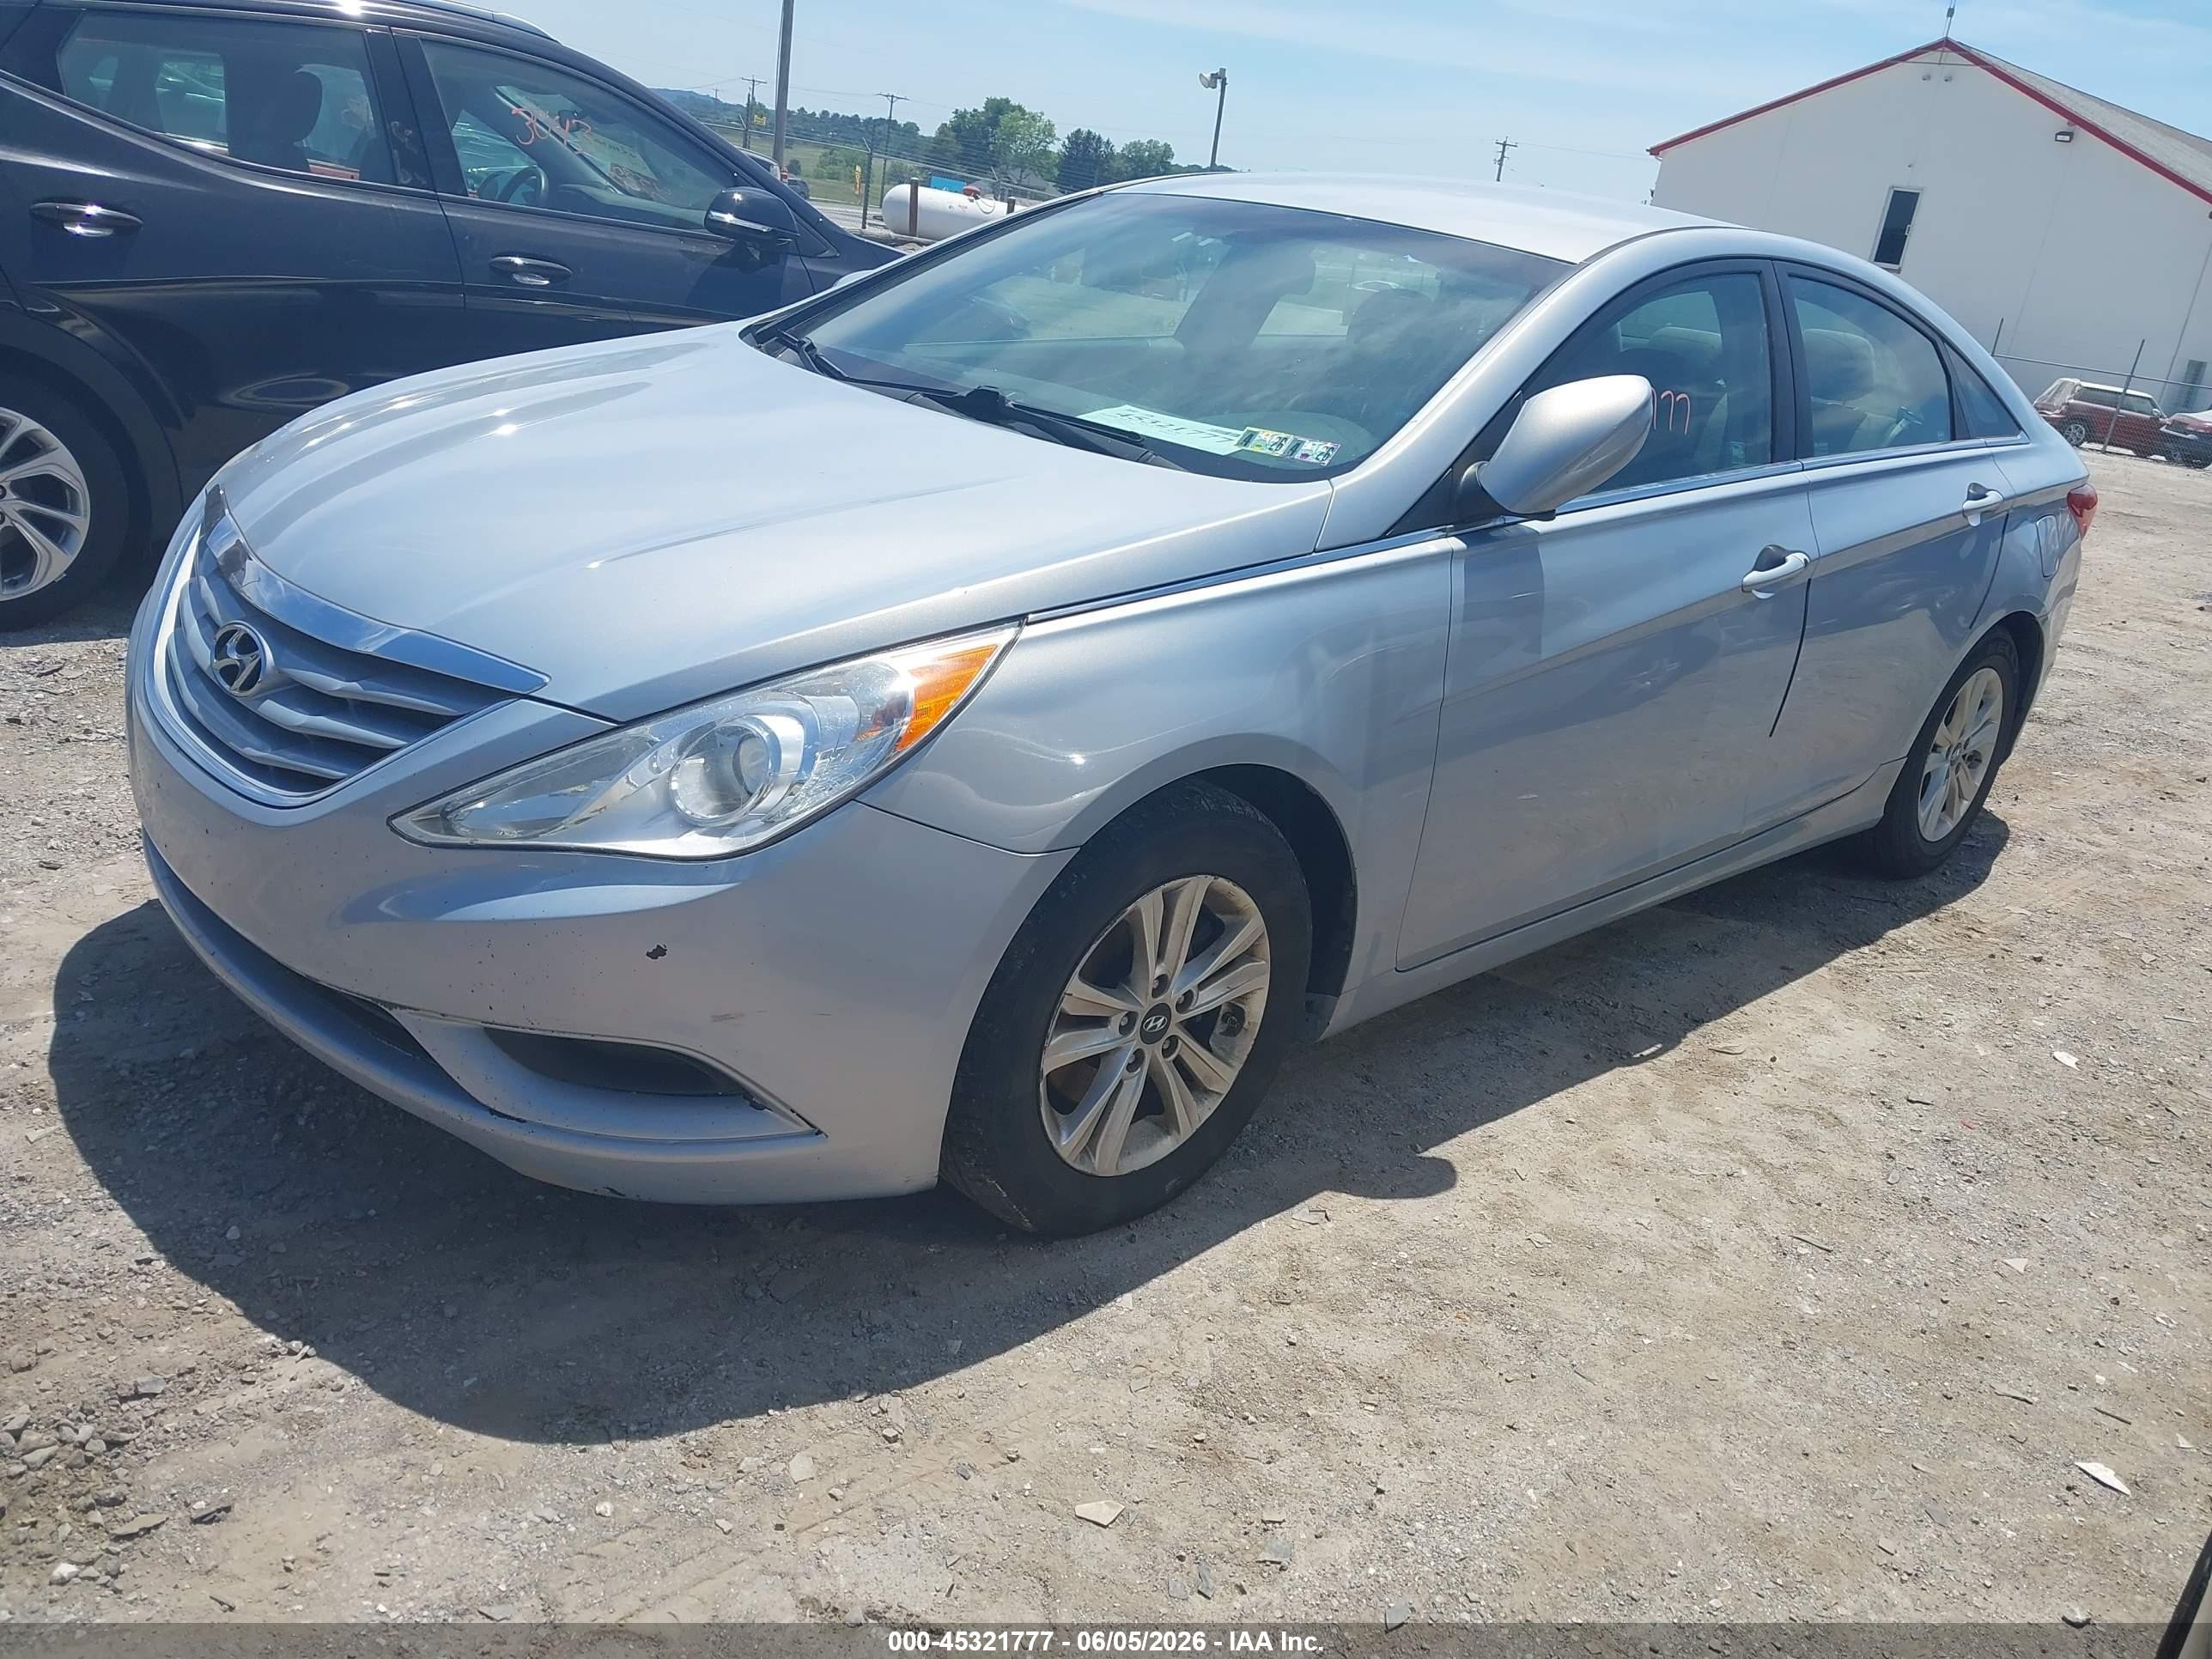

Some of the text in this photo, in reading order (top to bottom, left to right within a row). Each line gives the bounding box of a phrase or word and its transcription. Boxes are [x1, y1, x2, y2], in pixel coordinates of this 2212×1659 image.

[1241, 433, 1255, 447] 4
[1268, 436, 1288, 452] 26
[1287, 442, 1334, 462] 4 26
